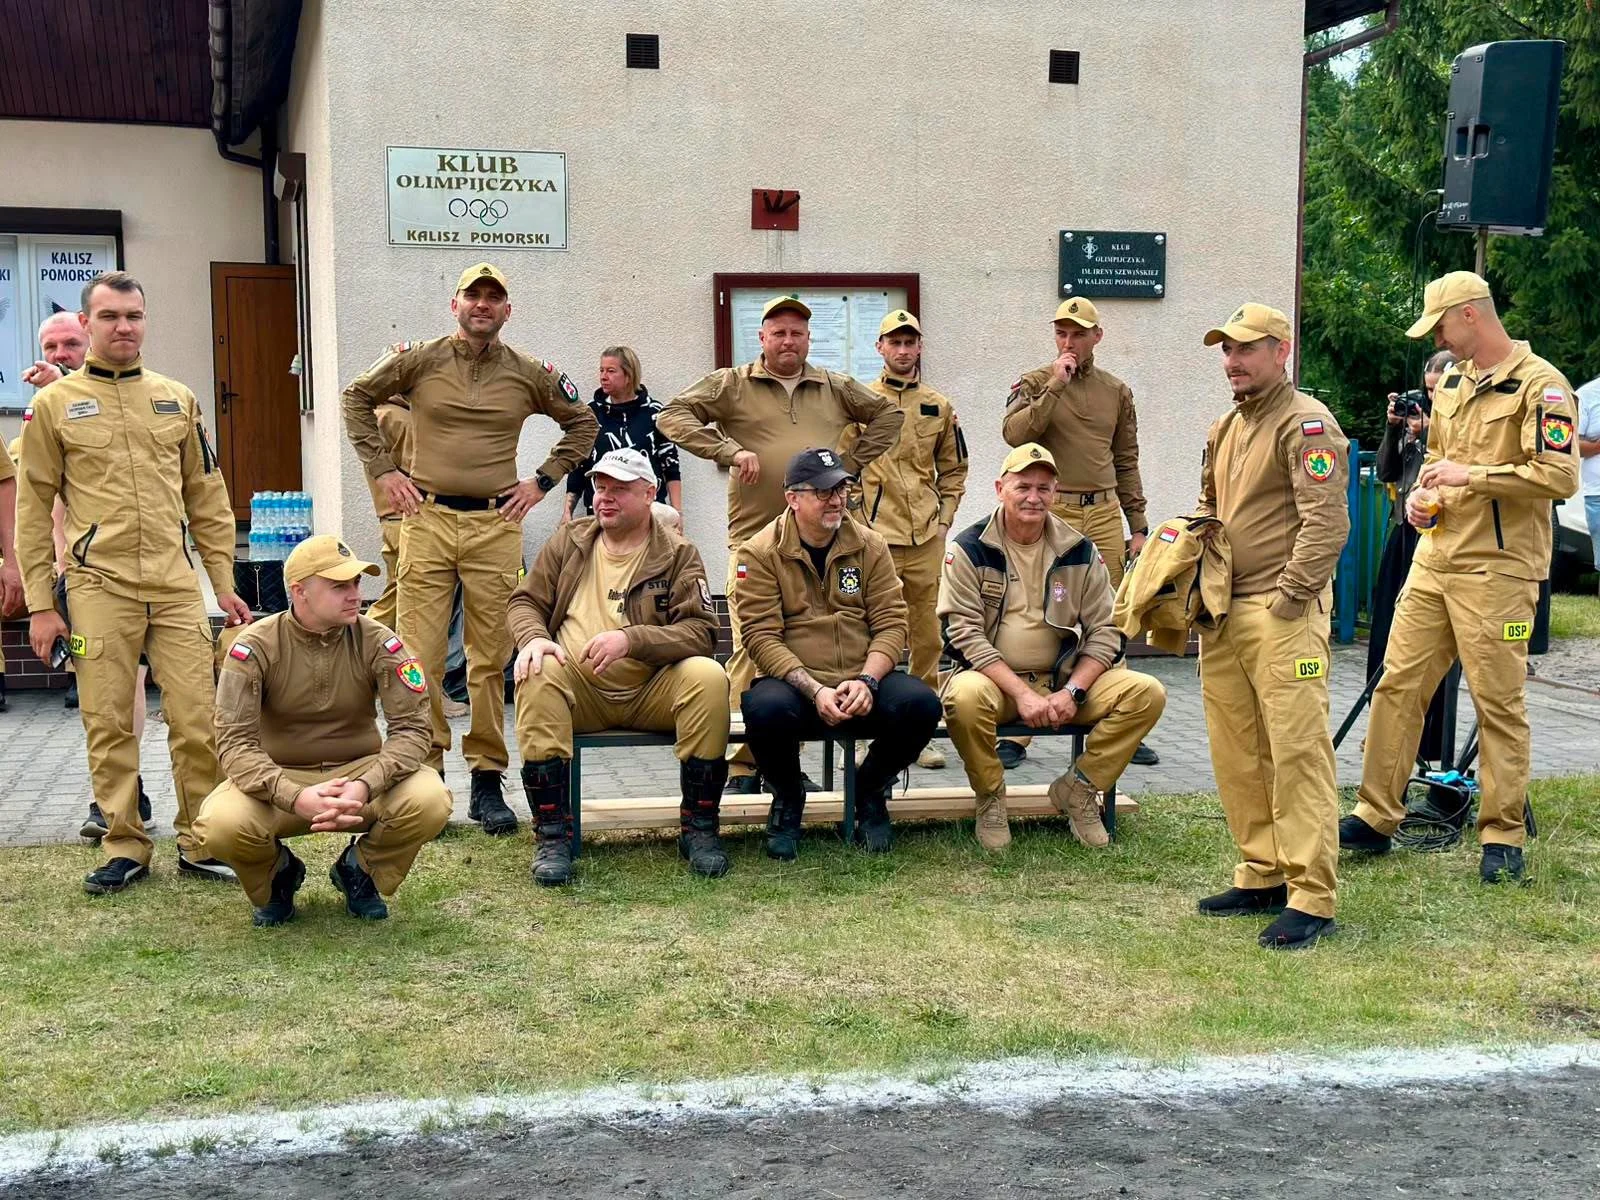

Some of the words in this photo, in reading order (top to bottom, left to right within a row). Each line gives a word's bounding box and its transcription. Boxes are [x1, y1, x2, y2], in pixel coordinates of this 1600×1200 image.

[437, 154, 518, 174] KLUB
[396, 175, 557, 192] OLIMPIJCZYKA
[407, 230, 460, 242] KALISZ
[471, 232, 550, 244] POMORSKI
[51, 252, 93, 265] KALISZ
[41, 269, 103, 281] POMORSK
[647, 579, 670, 590] STR
[1508, 625, 1527, 637] OSP
[1300, 662, 1319, 676] OSP
